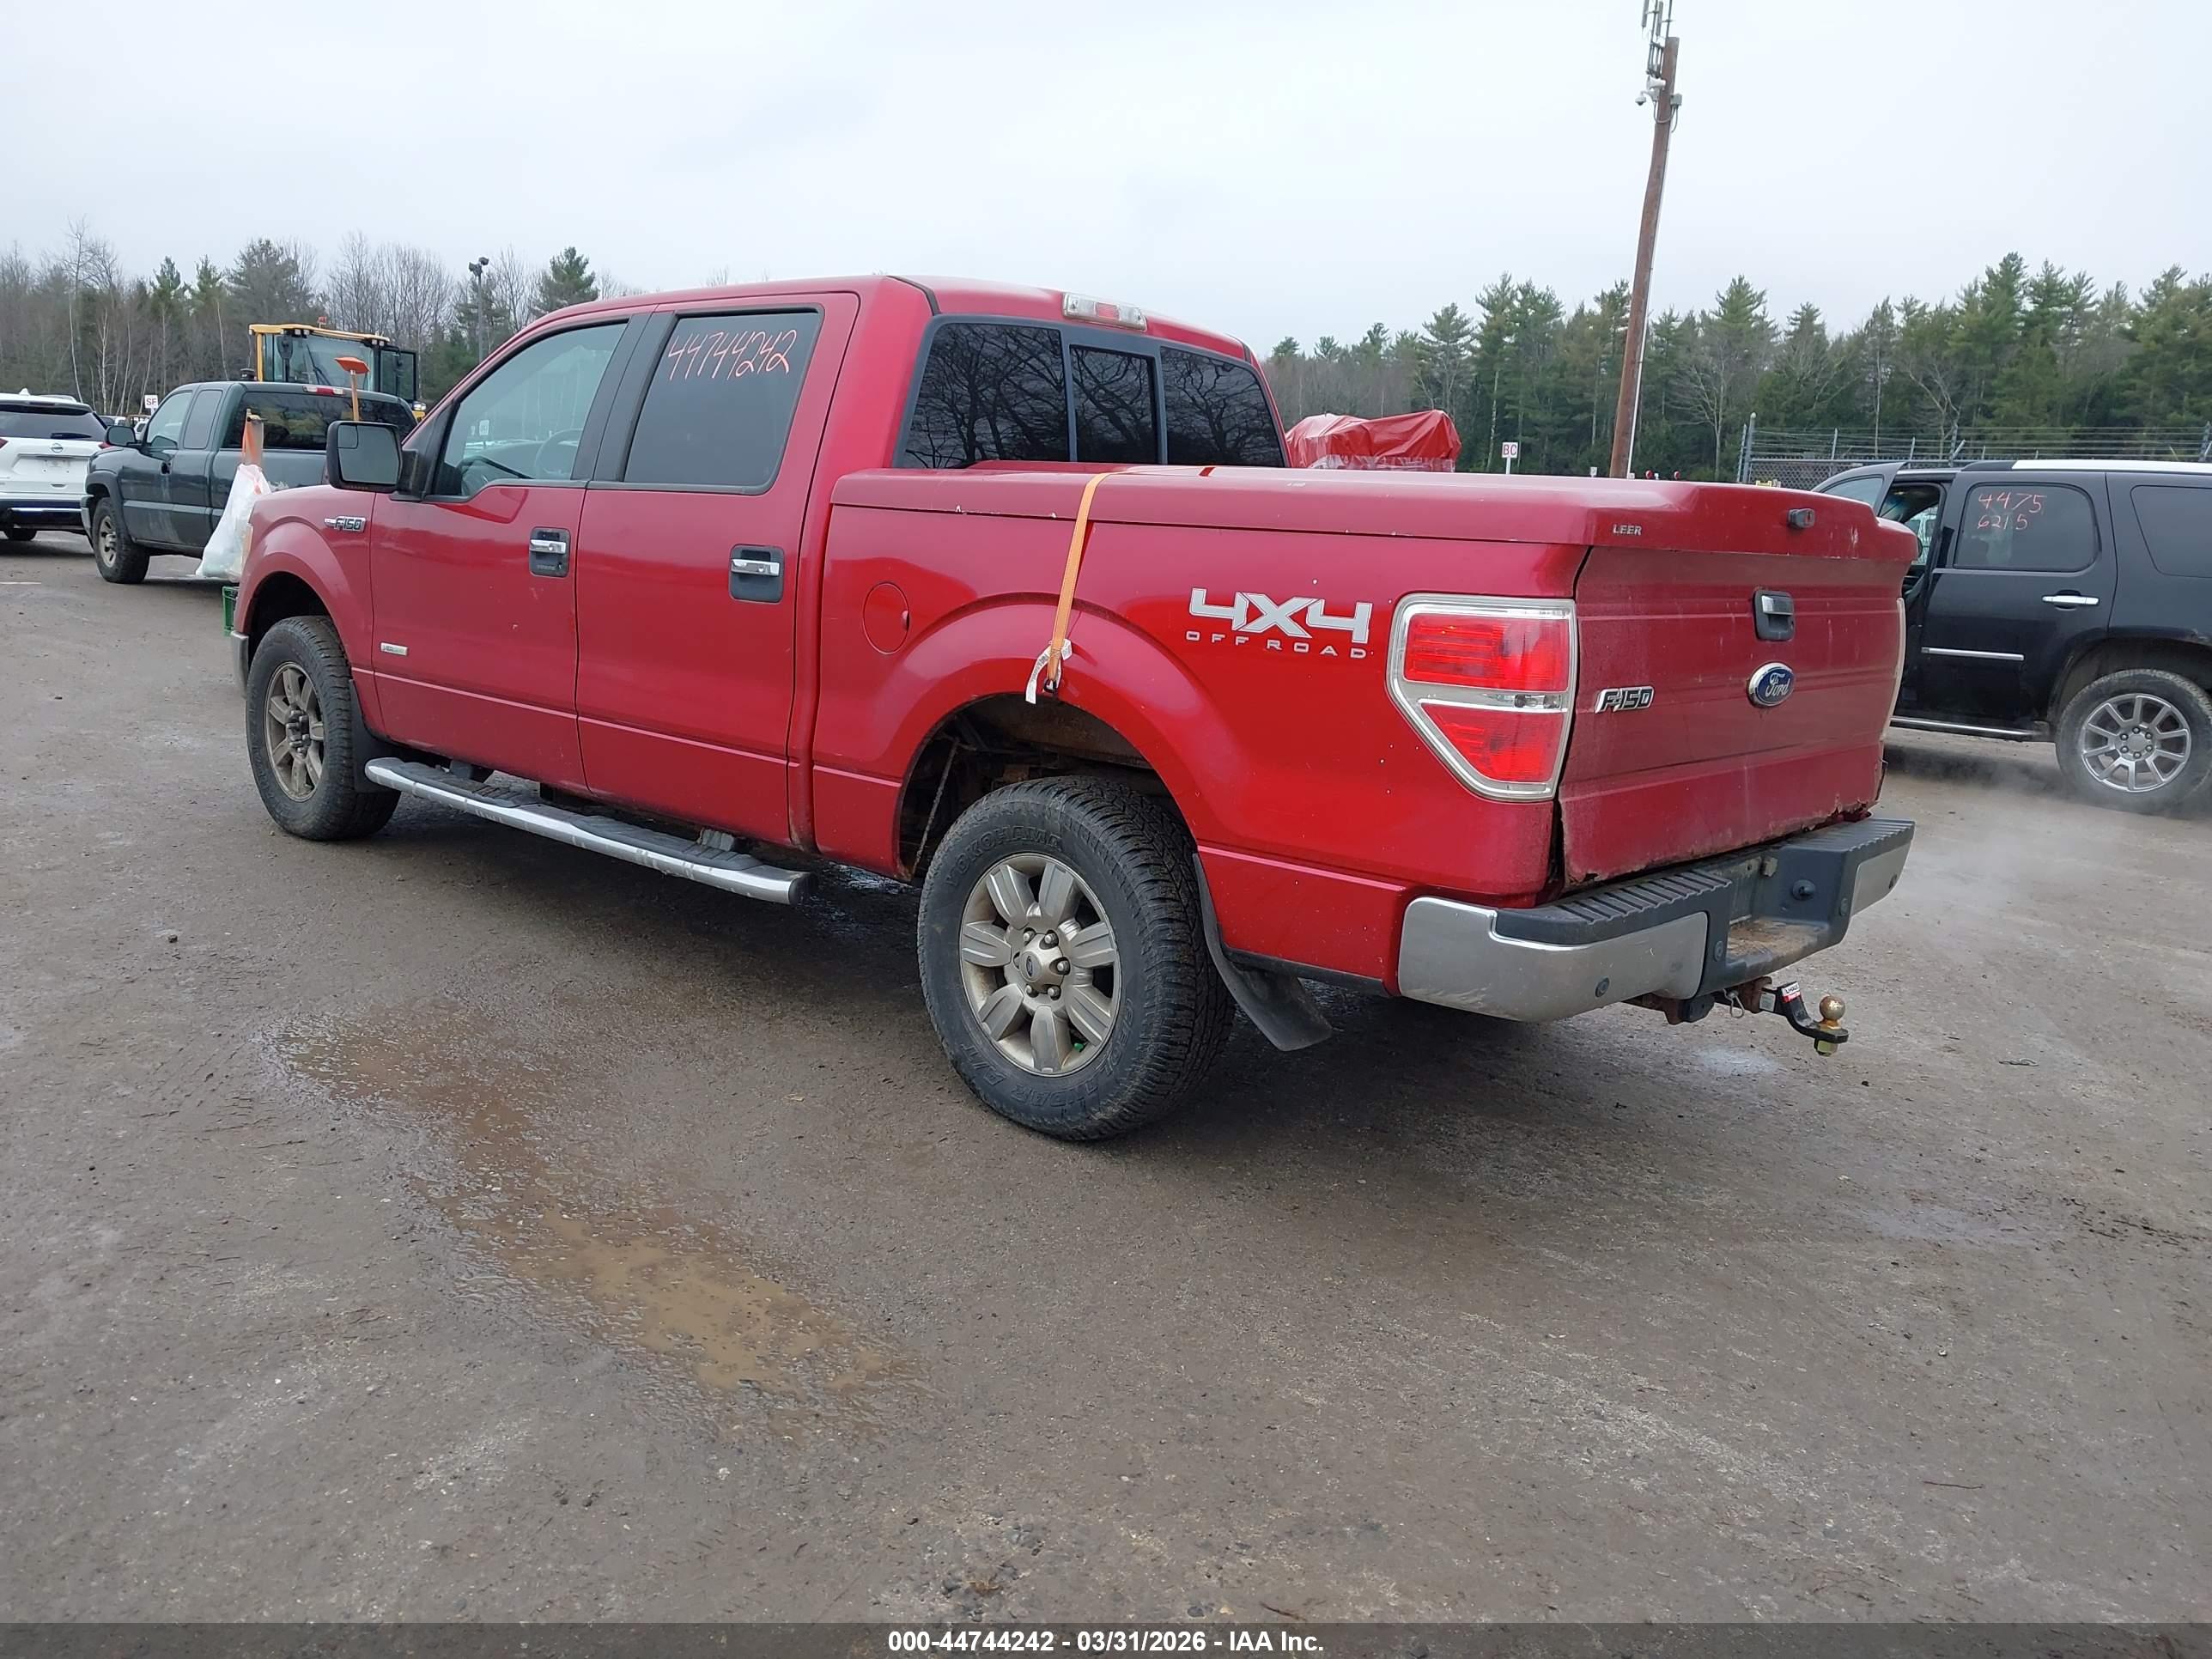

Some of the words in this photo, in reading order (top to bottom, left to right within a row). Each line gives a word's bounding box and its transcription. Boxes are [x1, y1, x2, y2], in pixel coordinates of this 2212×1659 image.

[668, 329, 798, 380] 44744242
[1504, 444, 1517, 456] BC
[1978, 492, 2048, 514] 4475
[1613, 524, 1642, 536] LEER
[1977, 514, 2028, 531] 6215
[1186, 630, 1249, 647] OFF
[1267, 639, 1367, 659] ROAD
[1765, 672, 1791, 697] Ford
[945, 825, 1063, 886] YOKOHAMA
